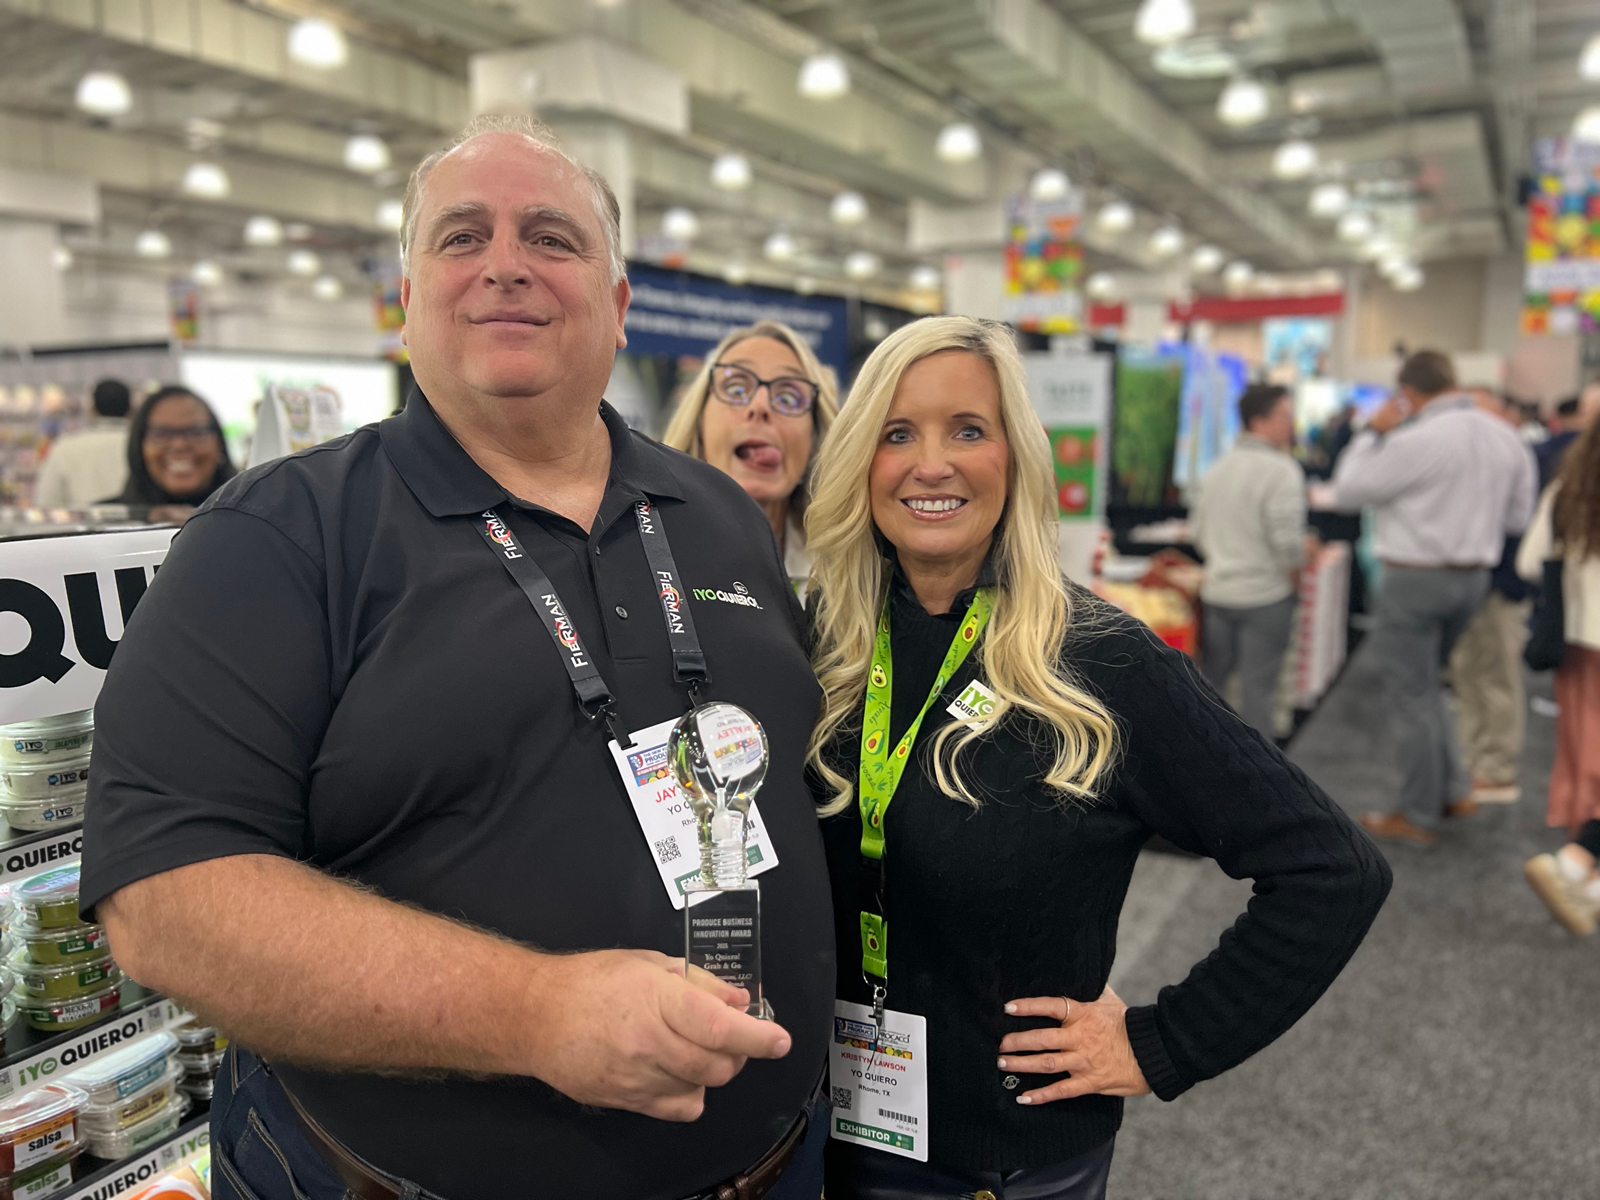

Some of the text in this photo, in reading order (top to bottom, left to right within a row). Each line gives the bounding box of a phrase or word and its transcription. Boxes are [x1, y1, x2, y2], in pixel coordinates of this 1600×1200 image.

[481, 509, 522, 560] FIERMA
[656, 571, 685, 634] FIERMAN
[0, 565, 163, 688] QU
[541, 593, 588, 668] FIERMAN
[655, 785, 677, 803] JAY
[667, 804, 682, 815] YO
[681, 817, 697, 827] Rho
[692, 917, 753, 927] PRODUCE BUSINESS
[693, 929, 752, 938] INNOVATION AWARD
[703, 962, 721, 970] Grab
[730, 961, 742, 969] Go
[704, 953, 714, 961] Yo
[19, 1018, 144, 1086] ¡YO QUIERO!
[841, 1052, 906, 1072] KRISTYN LAWSON
[851, 1069, 897, 1086] YO QUIERO
[858, 1084, 881, 1096] Rhome,
[28, 1130, 62, 1152] salsa
[840, 1122, 890, 1142] EXHIBITOR
[26, 1172, 59, 1195] salsa
